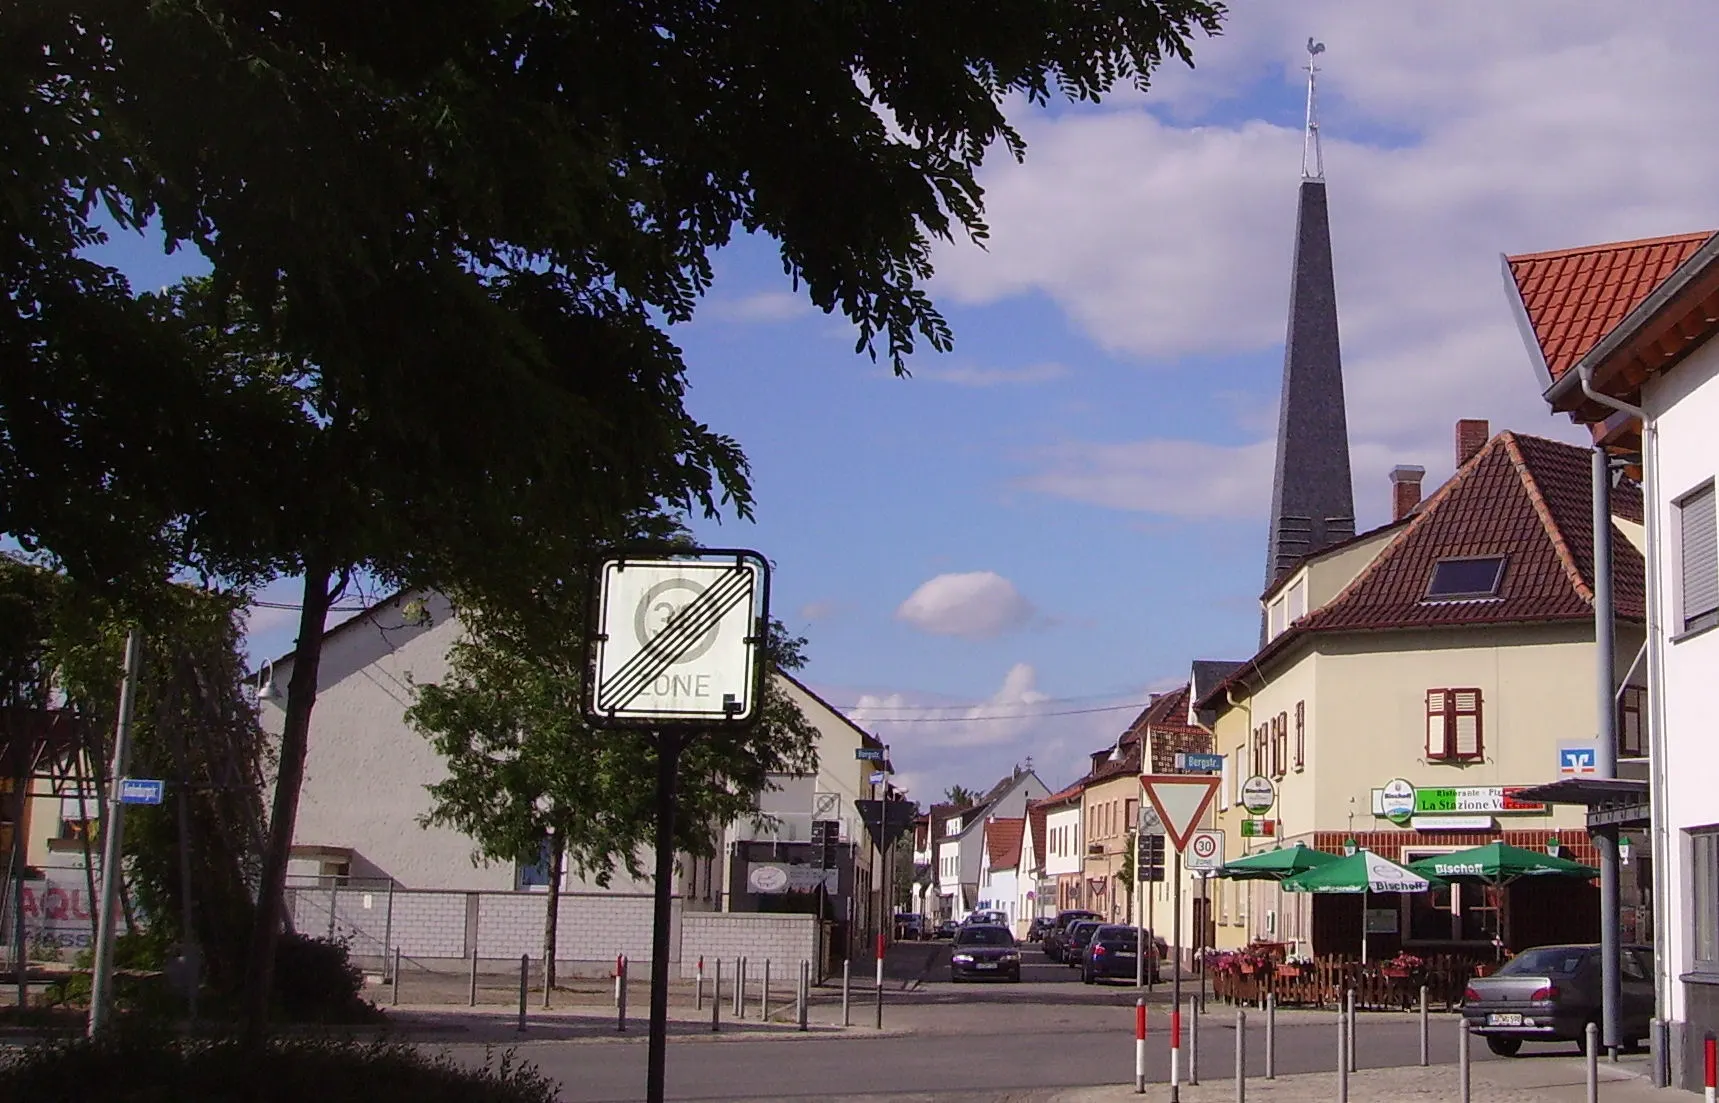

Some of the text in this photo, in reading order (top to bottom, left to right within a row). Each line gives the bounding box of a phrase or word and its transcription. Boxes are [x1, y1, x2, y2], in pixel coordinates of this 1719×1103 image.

[641, 673, 711, 697] ONE
[1188, 756, 1220, 768] Bergstr.
[1422, 801, 1436, 811] La
[1440, 800, 1489, 810] Stazione
[1198, 840, 1212, 852] 30
[1435, 863, 1483, 874] Bischoff
[1376, 881, 1423, 891] Bischoff
